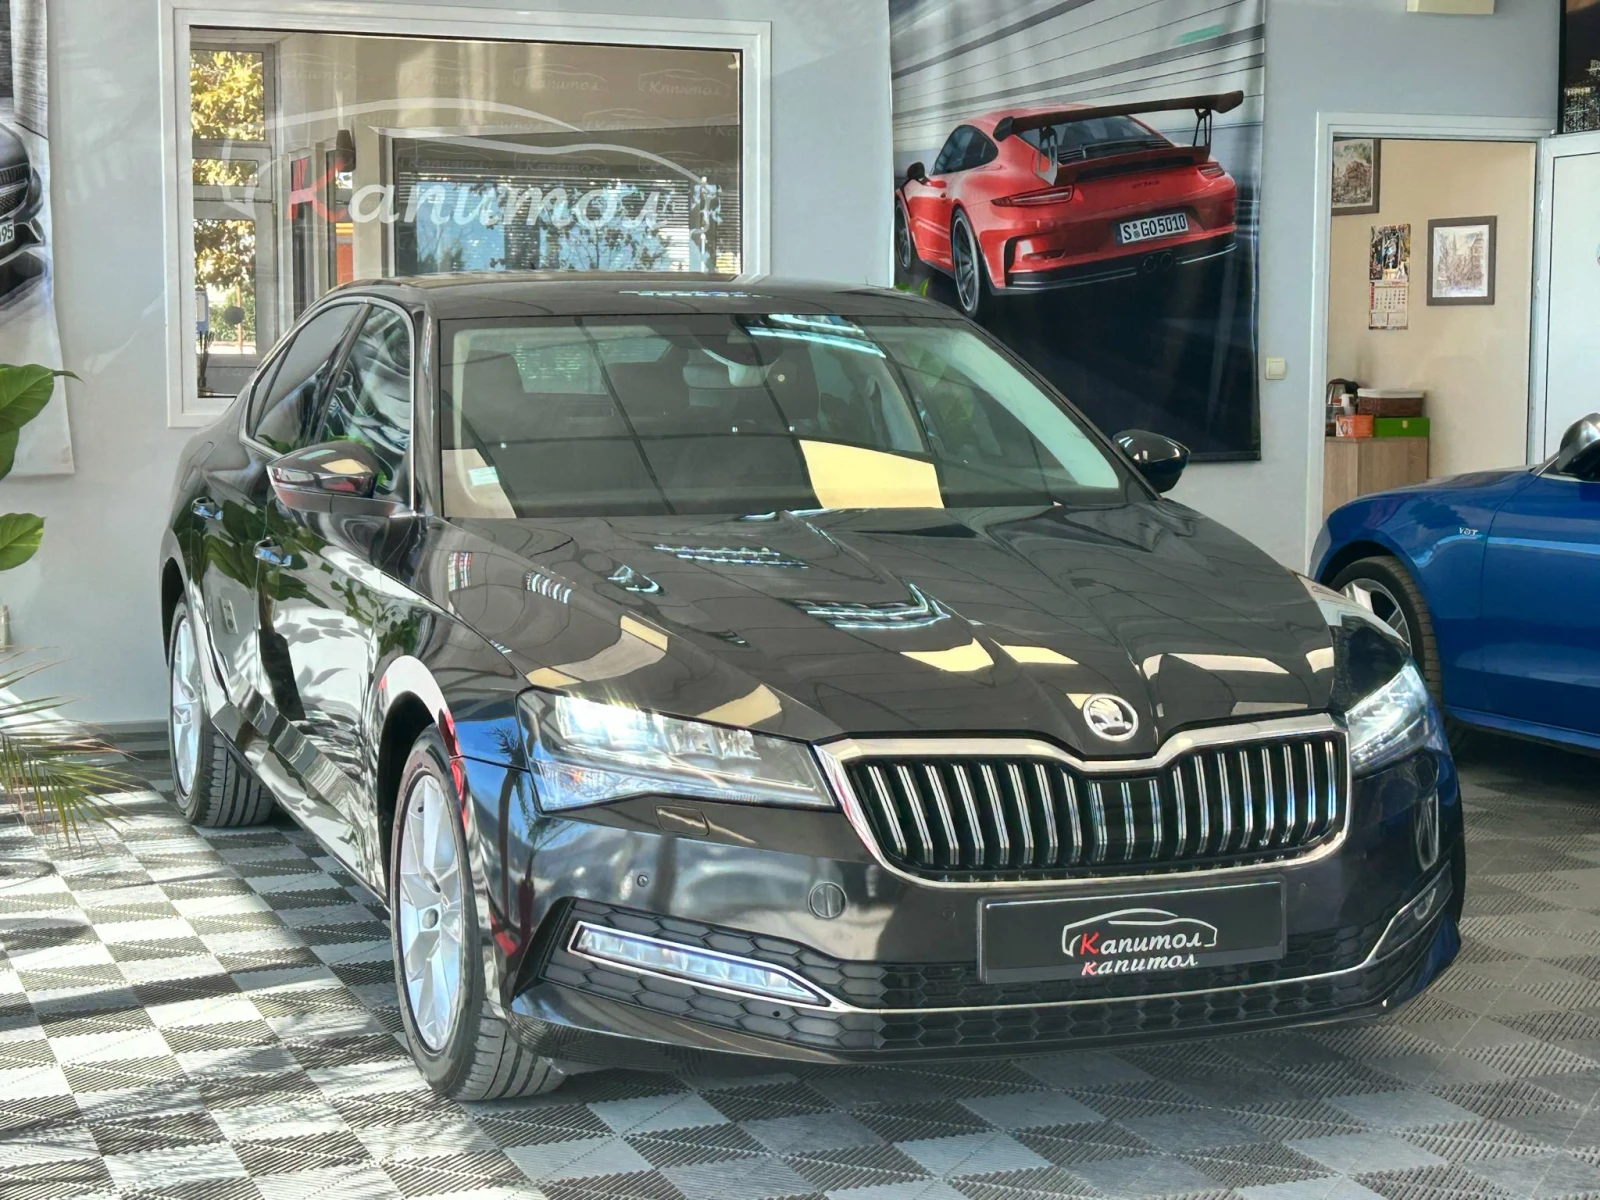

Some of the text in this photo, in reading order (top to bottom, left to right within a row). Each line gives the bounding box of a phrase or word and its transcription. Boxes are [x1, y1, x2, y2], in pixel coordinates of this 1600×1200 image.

[287, 157, 668, 230] Капитол
[1123, 225, 1132, 240] S
[1080, 931, 1202, 955] Капитол
